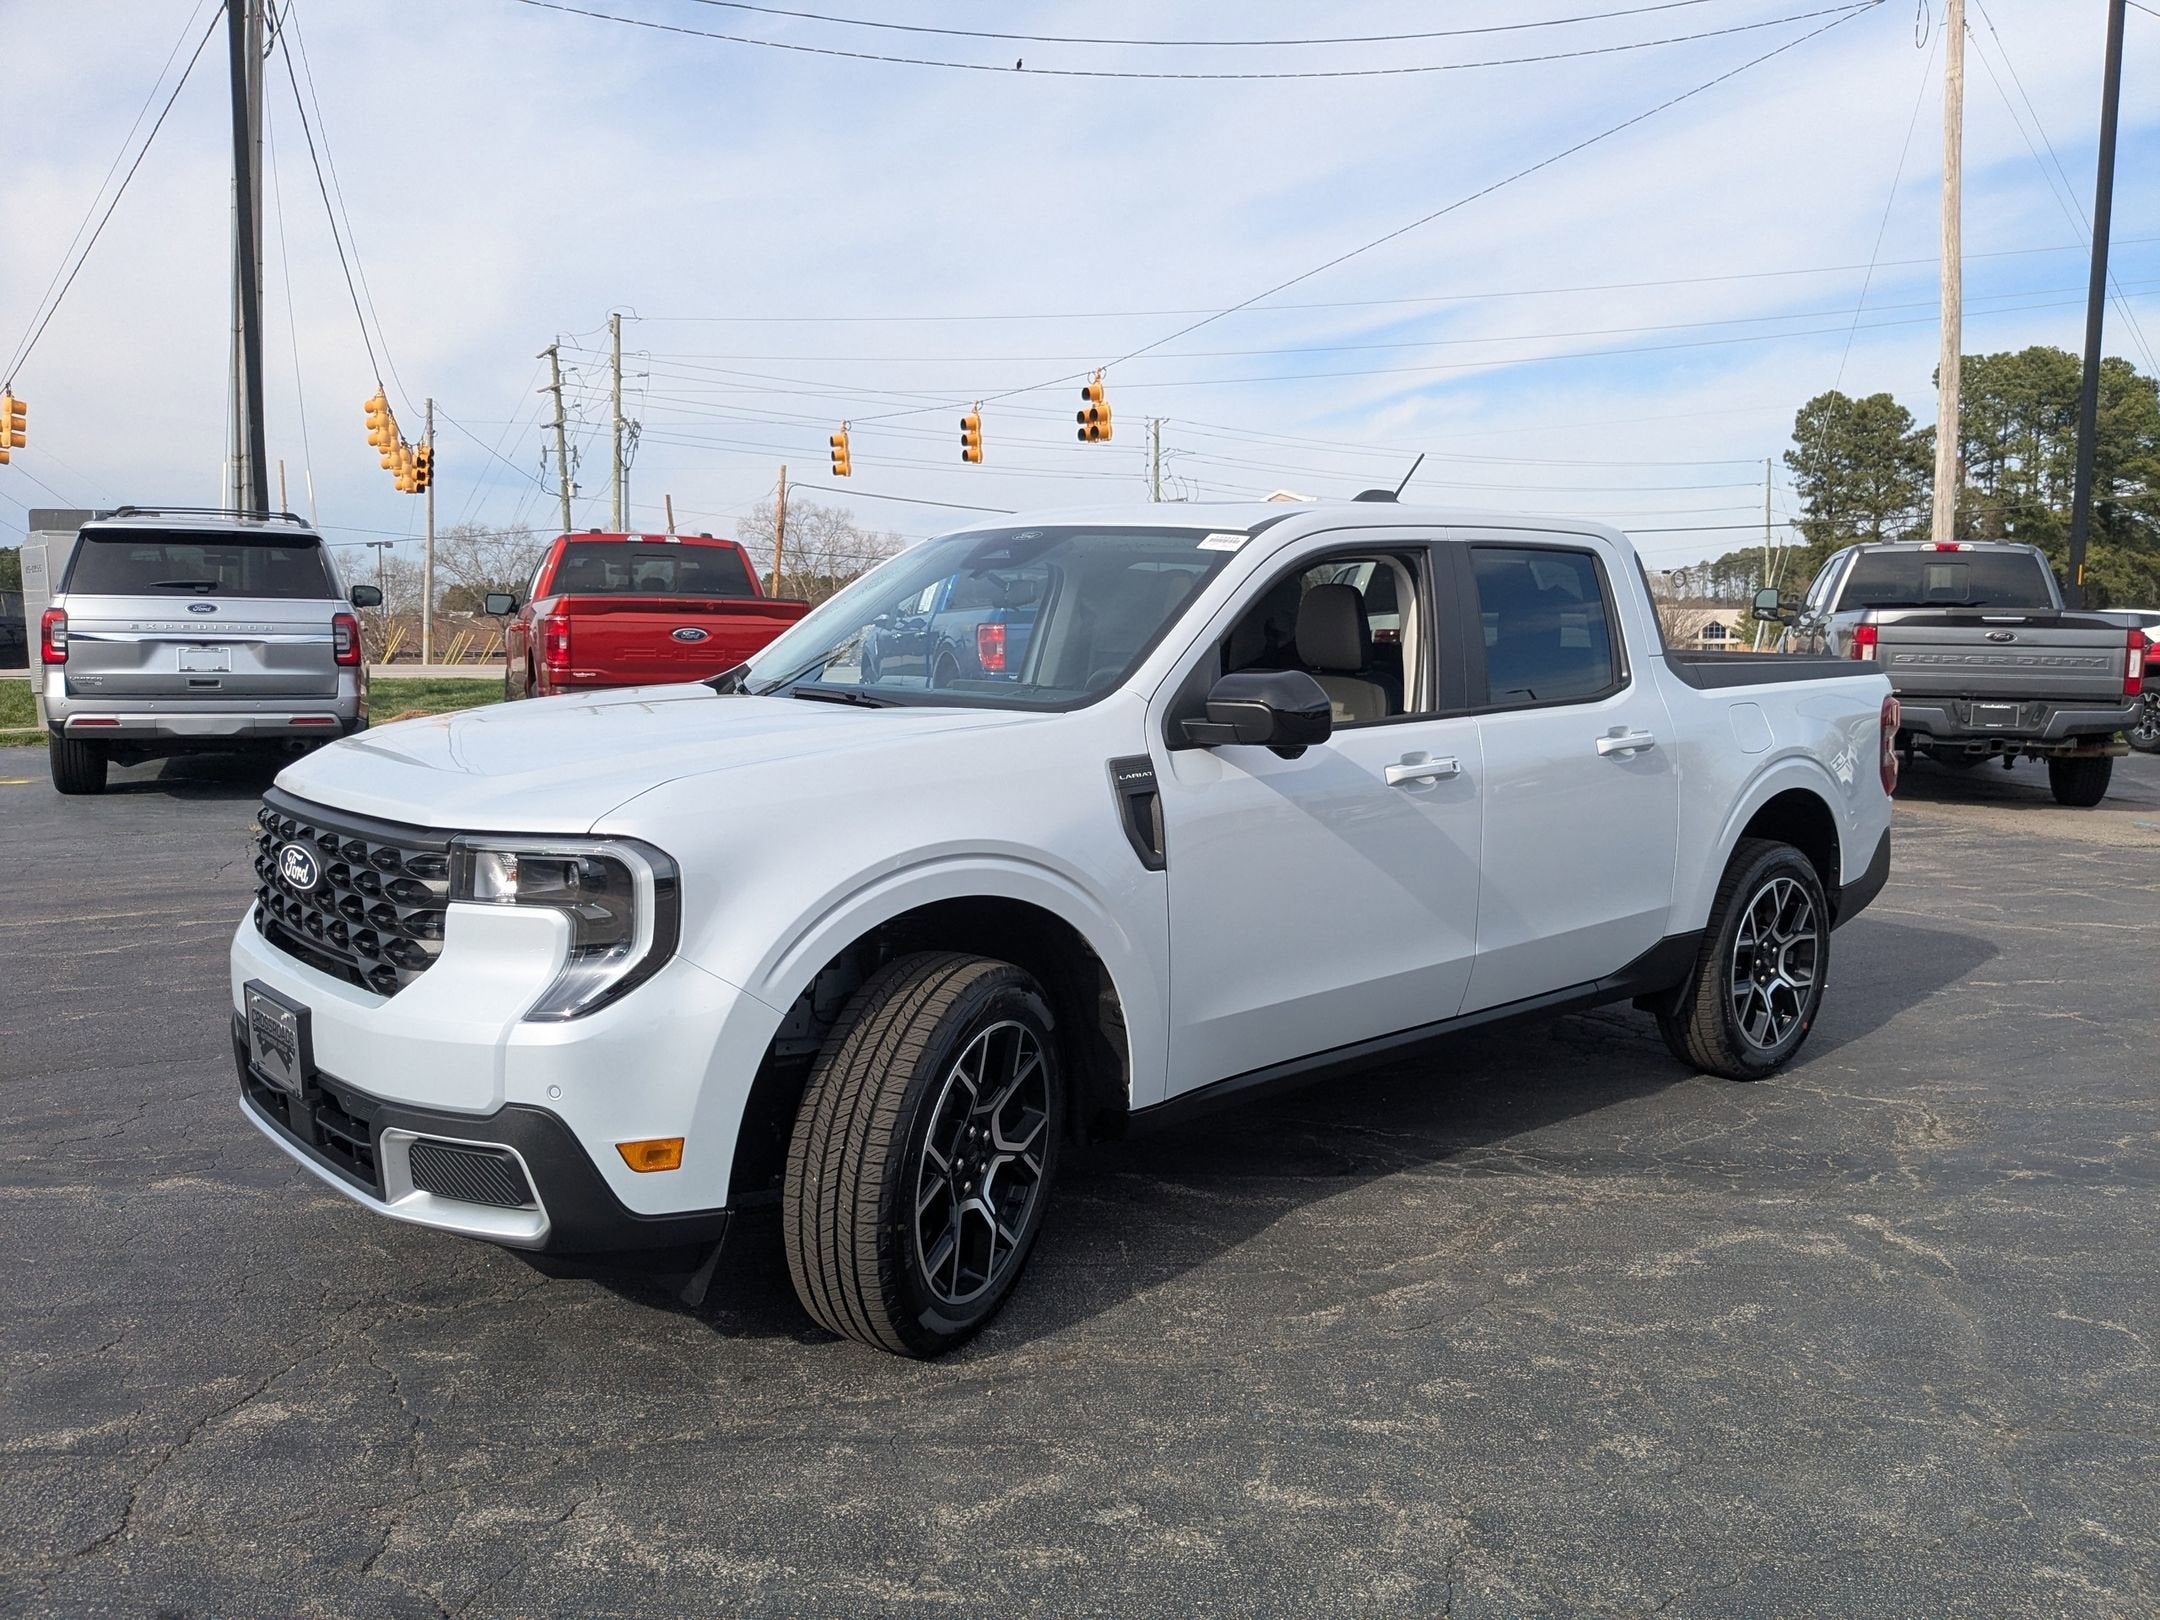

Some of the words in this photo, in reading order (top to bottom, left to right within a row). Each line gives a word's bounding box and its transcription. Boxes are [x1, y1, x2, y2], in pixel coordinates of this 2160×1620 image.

[129, 623, 274, 632] EXPEDITION
[1895, 654, 2010, 665] SUPER
[2016, 656, 2104, 667] DUTY
[1119, 771, 1152, 780] LARIAT
[285, 850, 309, 884] Ford
[252, 1007, 296, 1049] CROSSROADS
